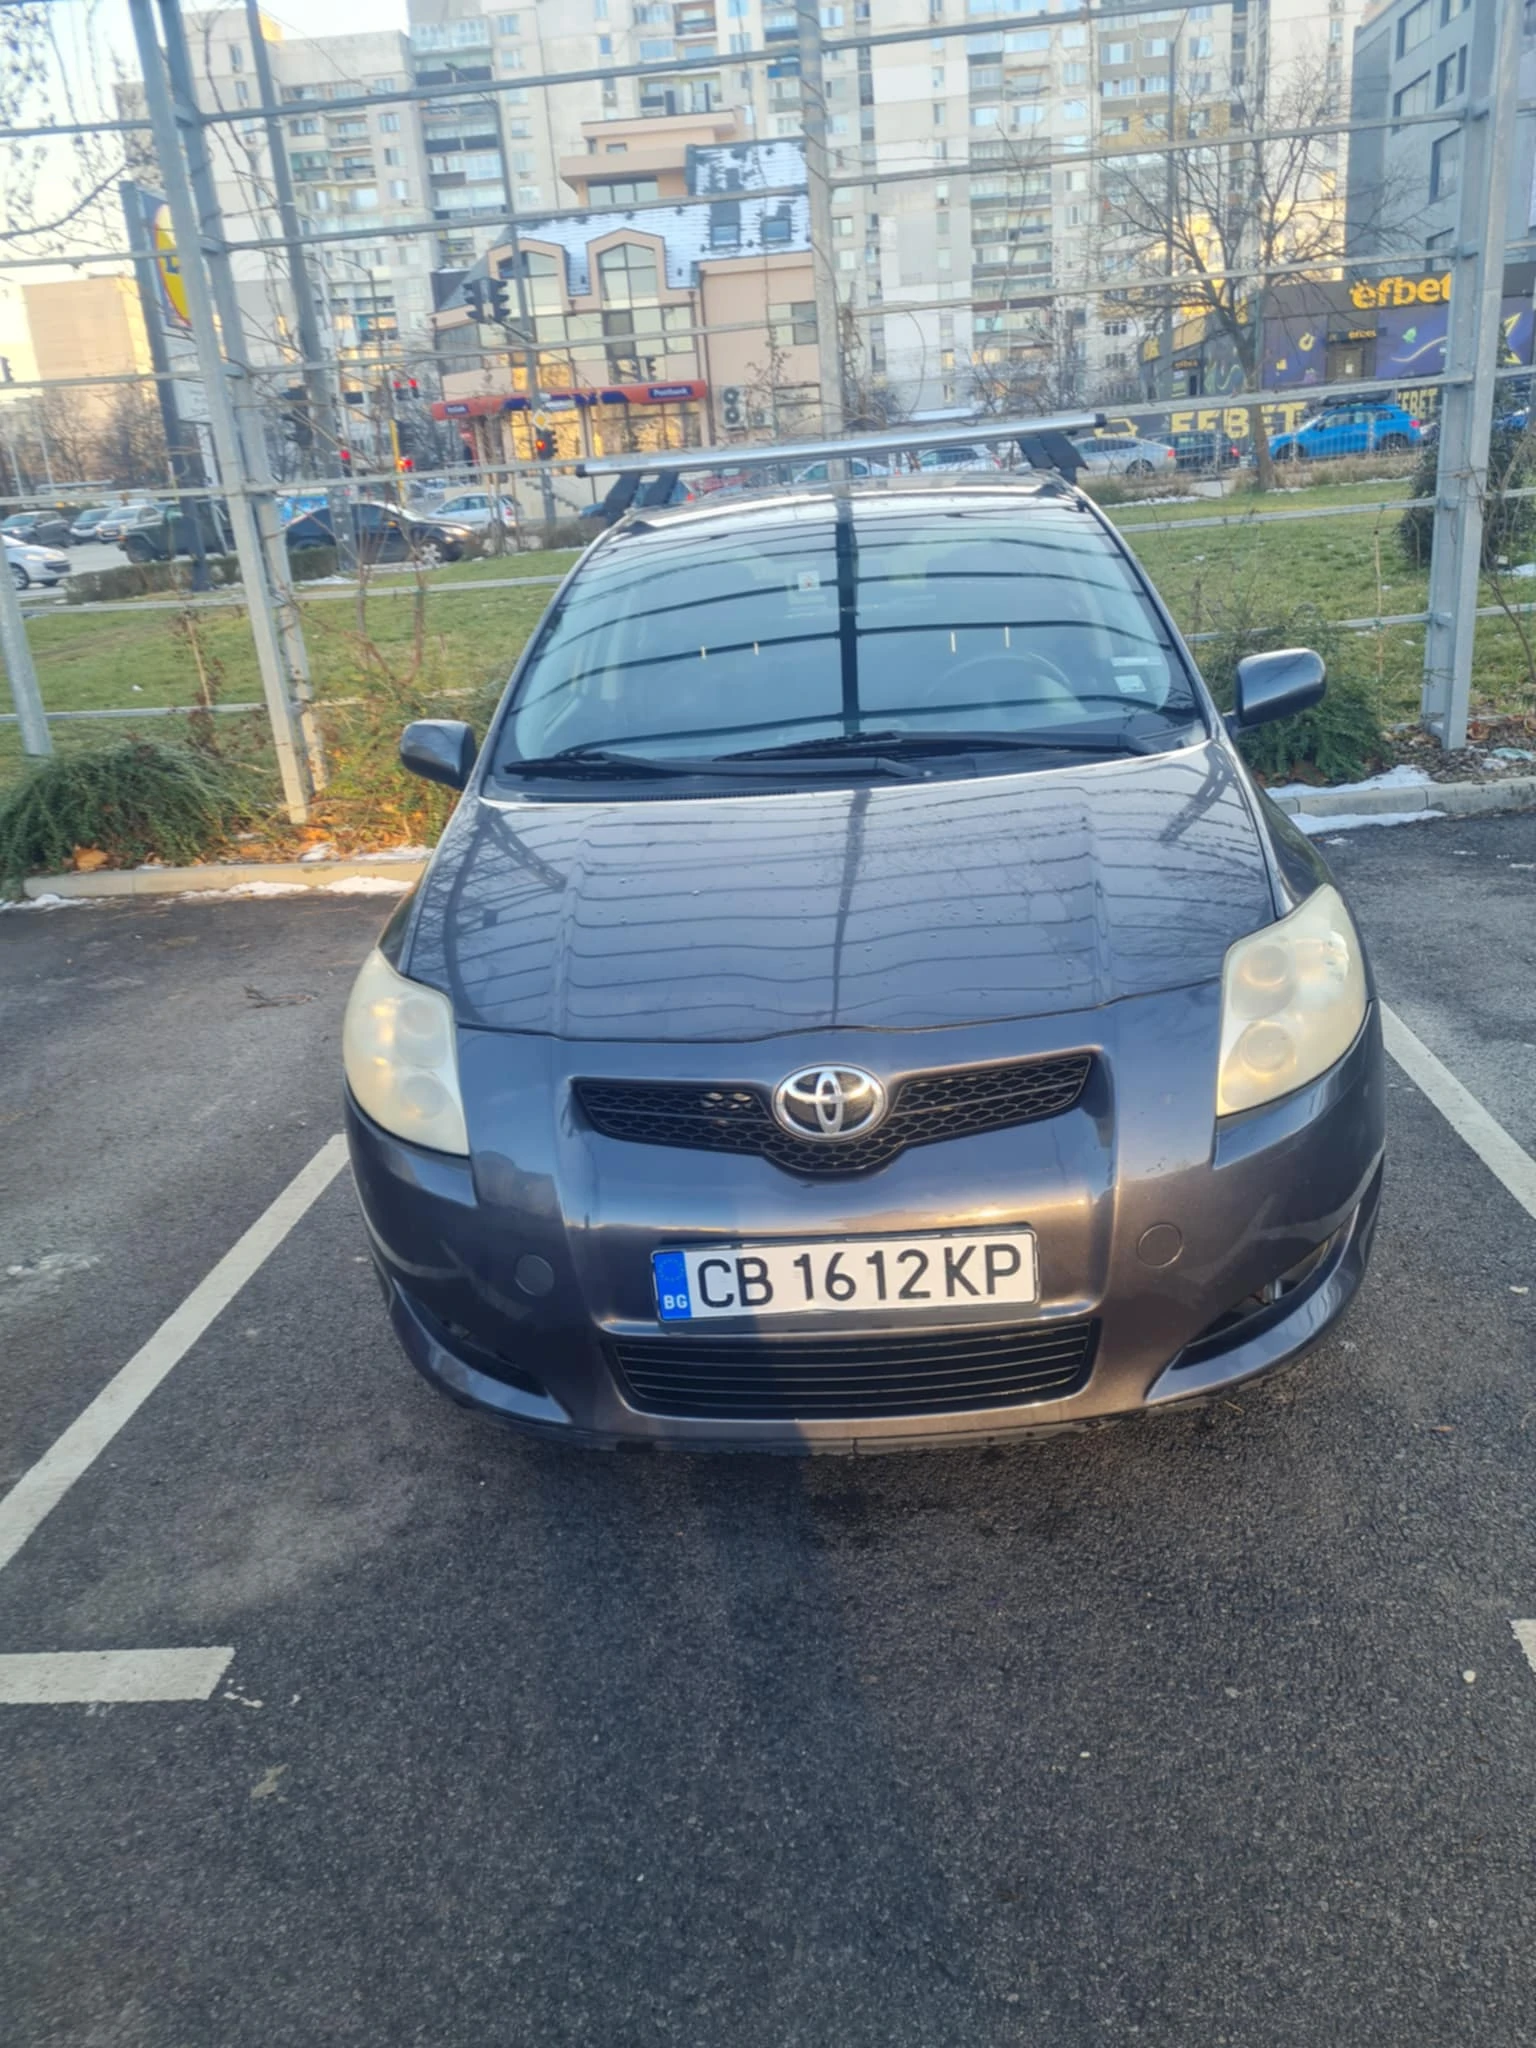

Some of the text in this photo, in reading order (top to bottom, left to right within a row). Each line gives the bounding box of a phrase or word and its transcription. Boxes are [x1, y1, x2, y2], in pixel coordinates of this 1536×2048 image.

[697, 1243, 1021, 1309] CB 1612 KP
[663, 1294, 688, 1310] BG
